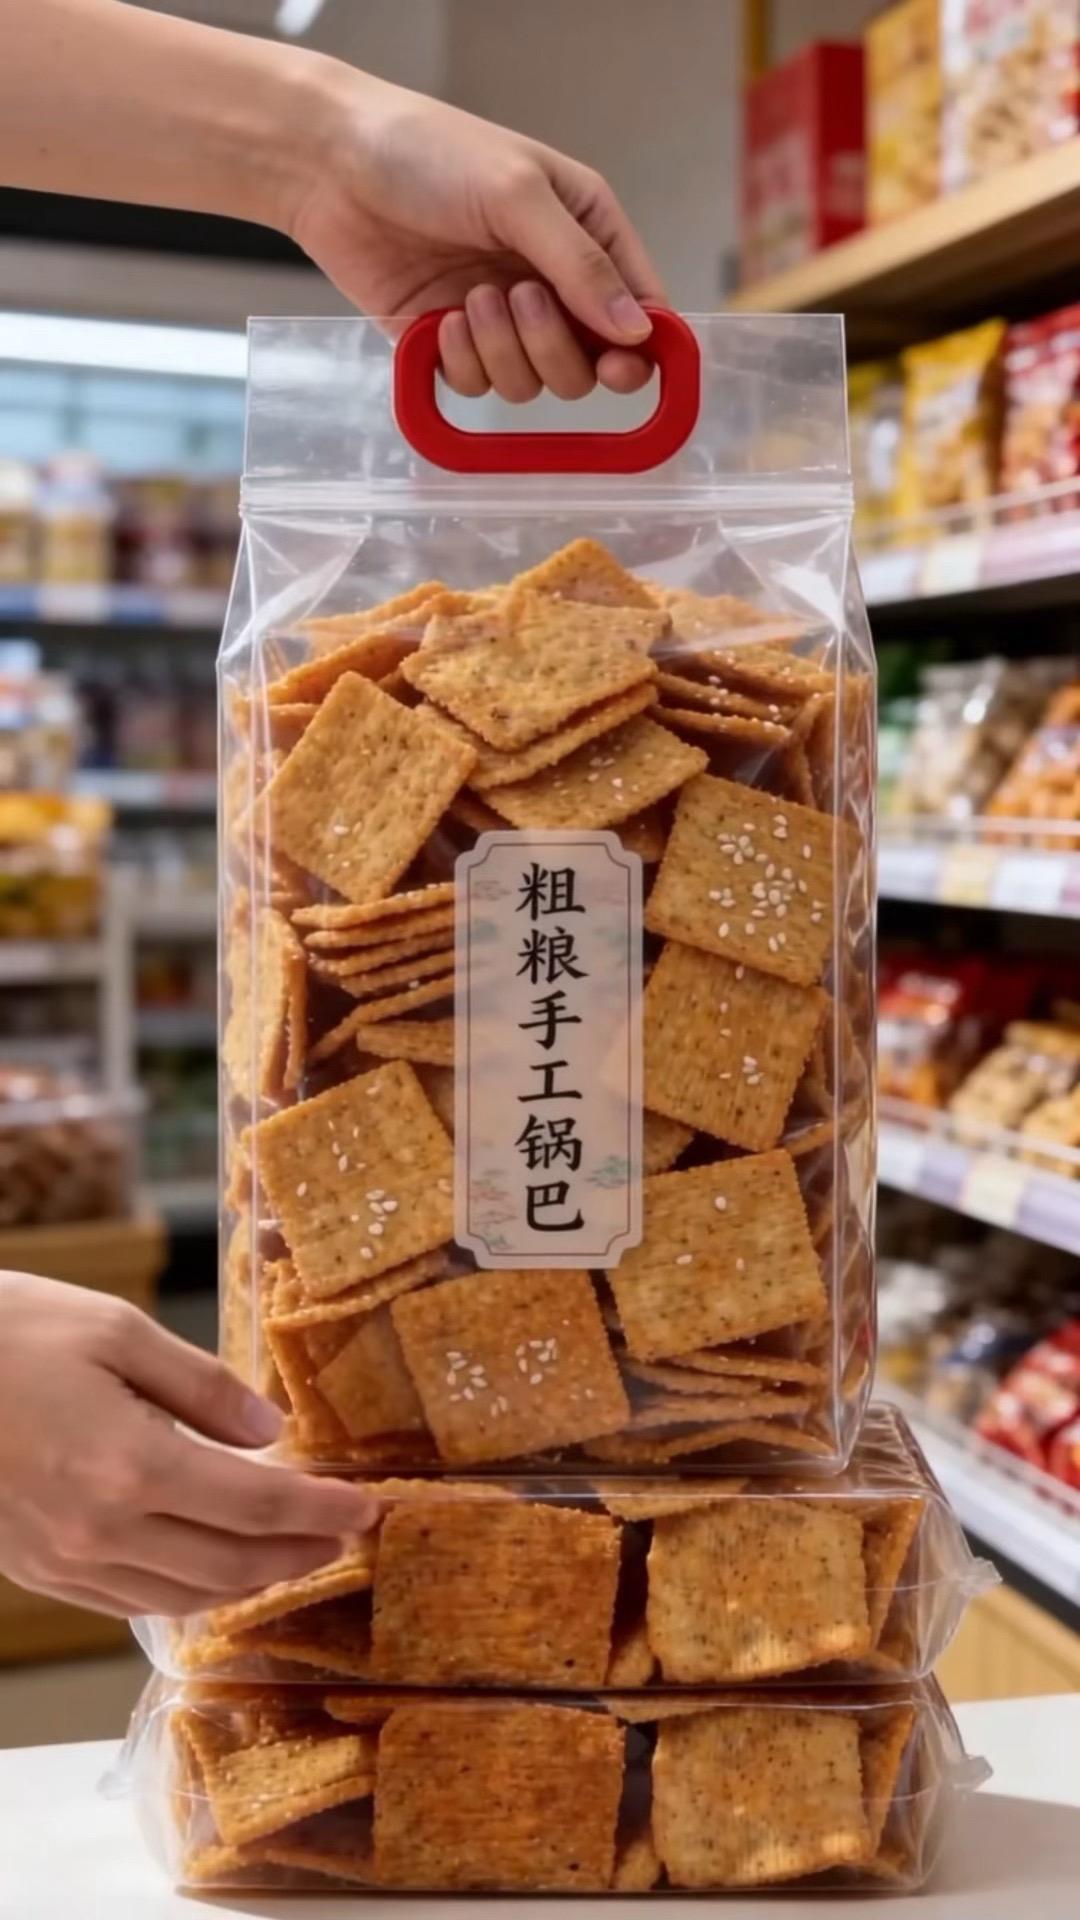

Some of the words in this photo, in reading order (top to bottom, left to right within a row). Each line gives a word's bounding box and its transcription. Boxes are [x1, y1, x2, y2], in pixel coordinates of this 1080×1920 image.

[515, 862, 589, 1232] 粗粮手工锅巴
